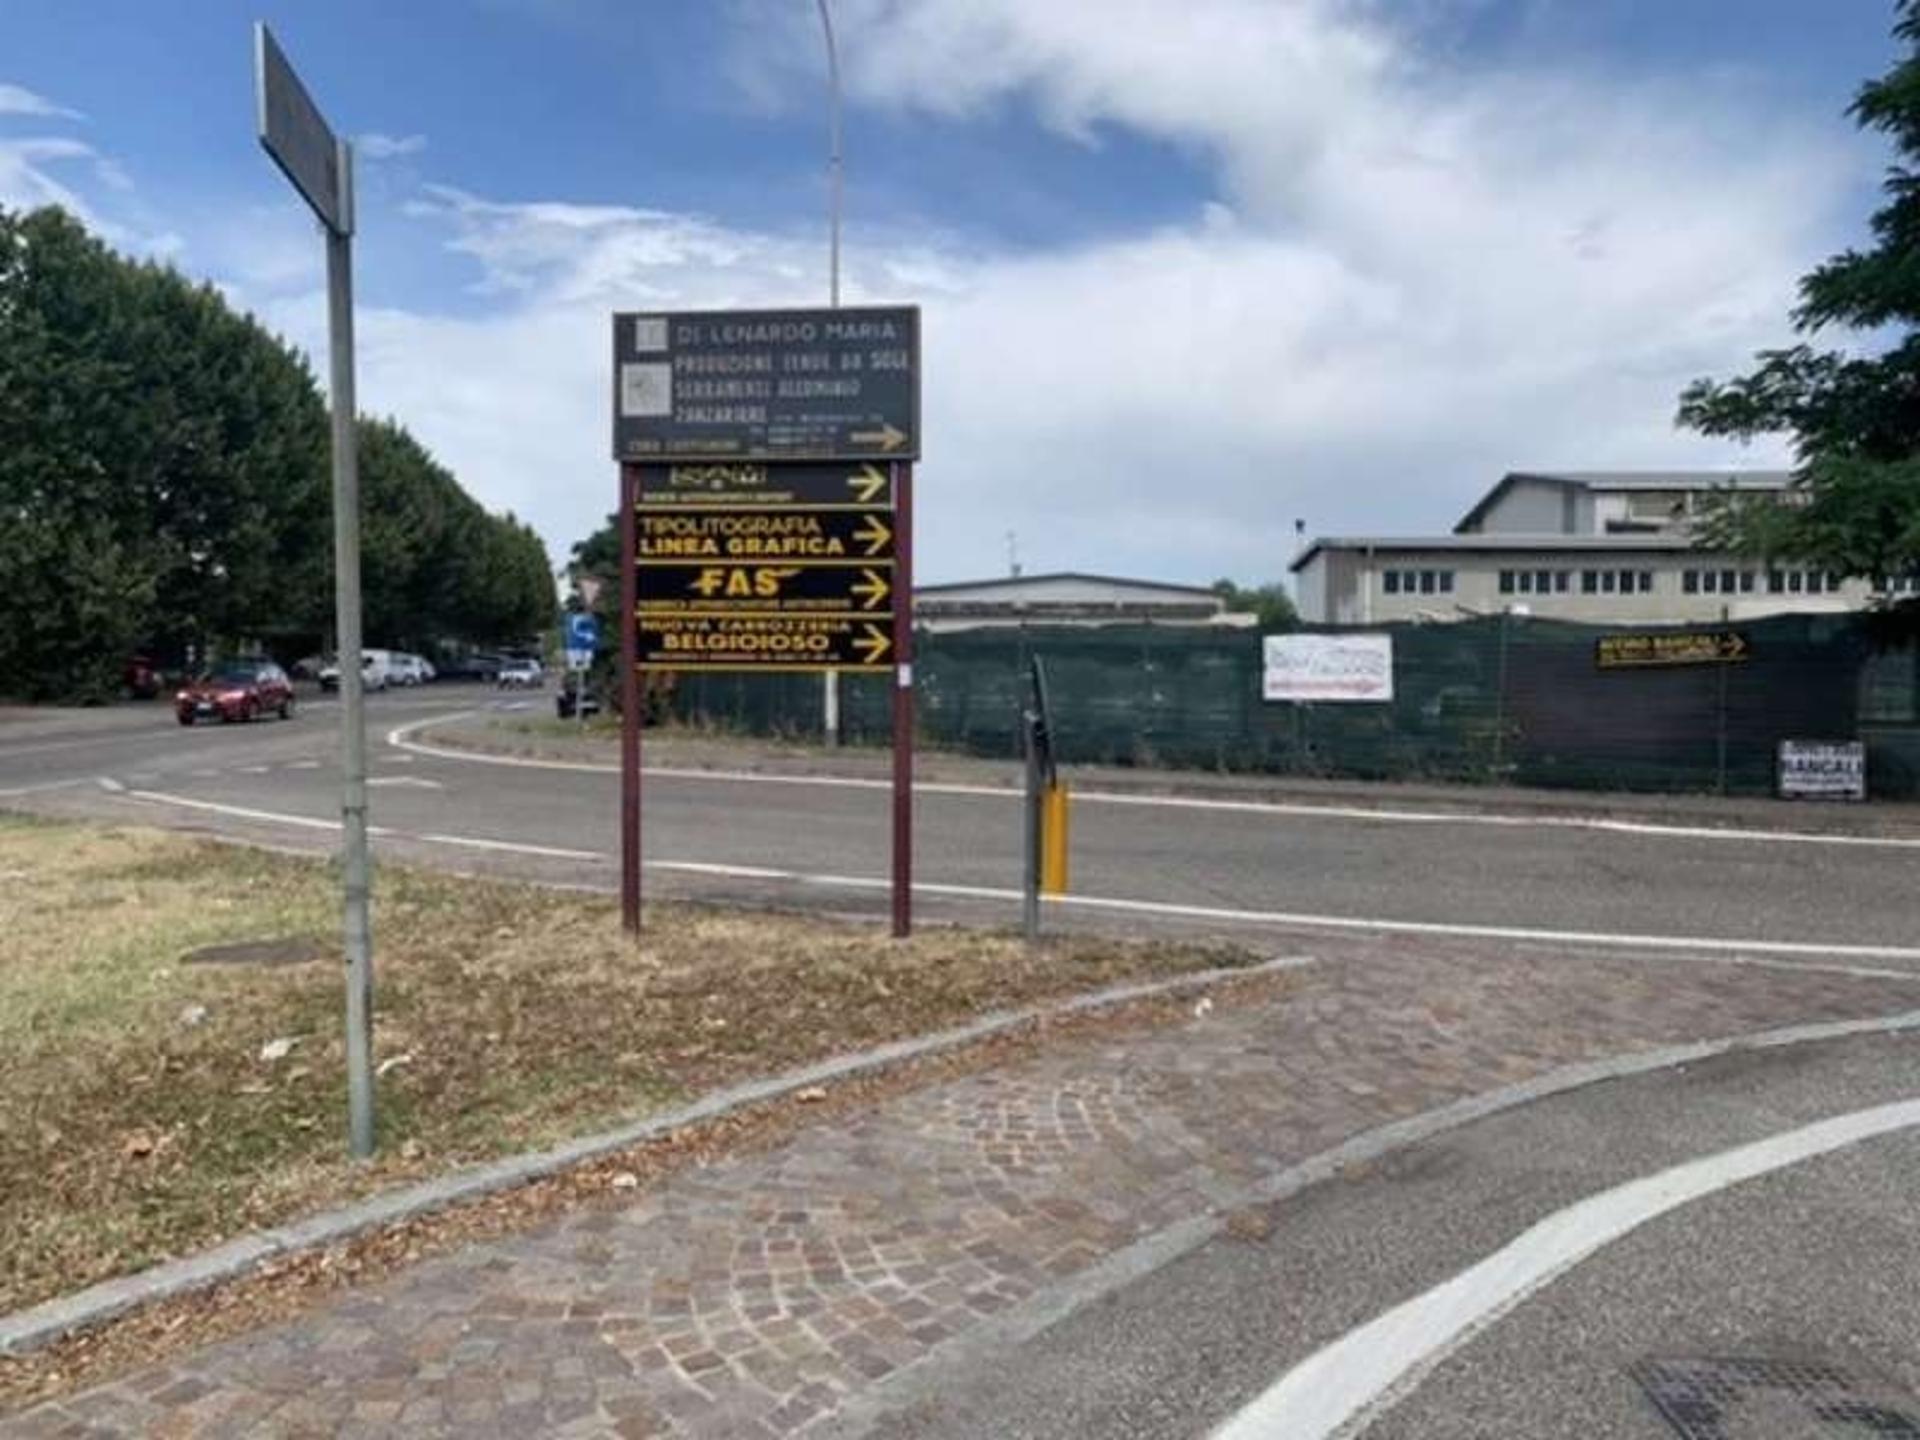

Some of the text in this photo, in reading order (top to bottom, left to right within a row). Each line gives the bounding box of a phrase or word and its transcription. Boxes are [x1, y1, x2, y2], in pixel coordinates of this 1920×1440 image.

[825, 319, 897, 340] MARIA
[639, 516, 821, 536] TIPOLITOGRAFIA
[639, 536, 846, 555] LINEA GRAFICA
[691, 567, 788, 597] FAS
[640, 621, 711, 632] NUOVA
[662, 633, 830, 651] BELGIOIOSO
